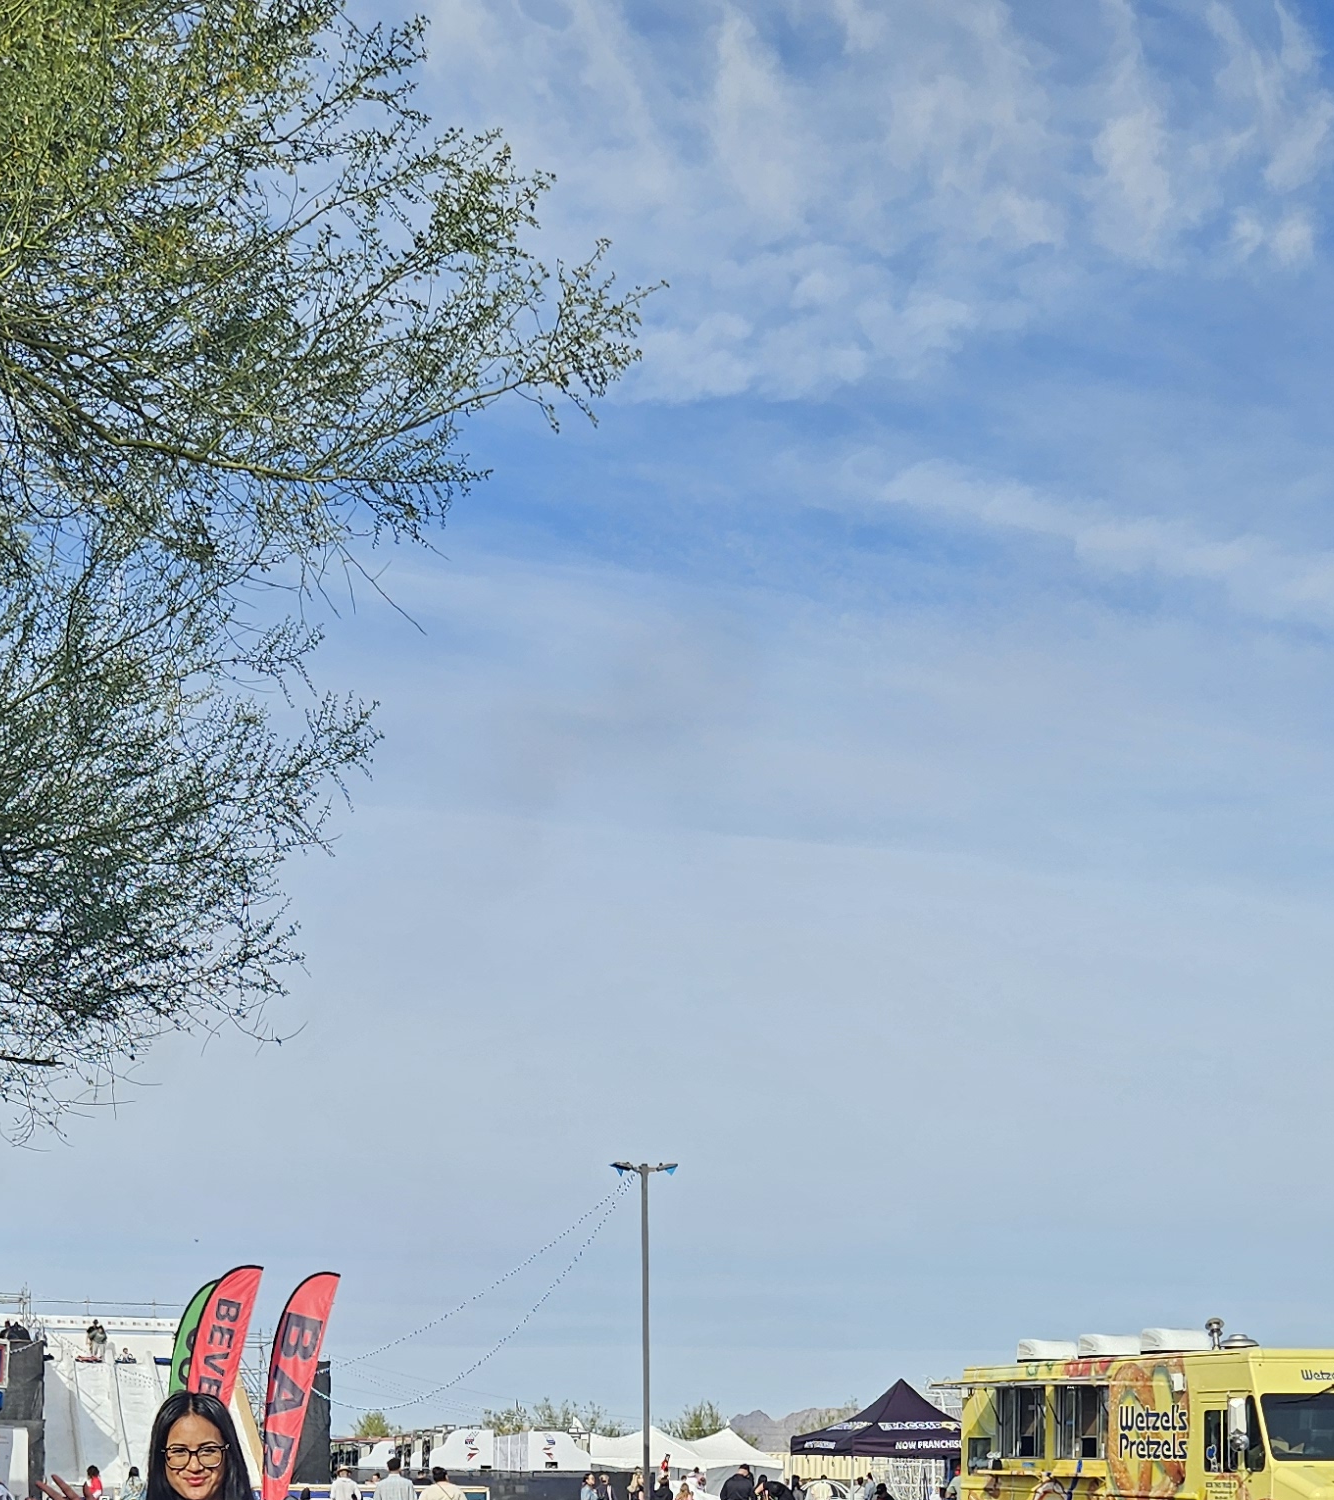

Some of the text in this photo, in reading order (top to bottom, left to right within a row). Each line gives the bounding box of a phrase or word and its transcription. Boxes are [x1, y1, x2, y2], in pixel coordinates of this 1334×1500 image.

[267, 1312, 324, 1480] BAR
[1119, 1404, 1188, 1432] Wetzel's
[895, 1441, 917, 1450] NOW
[1119, 1433, 1188, 1460] Pretzels
